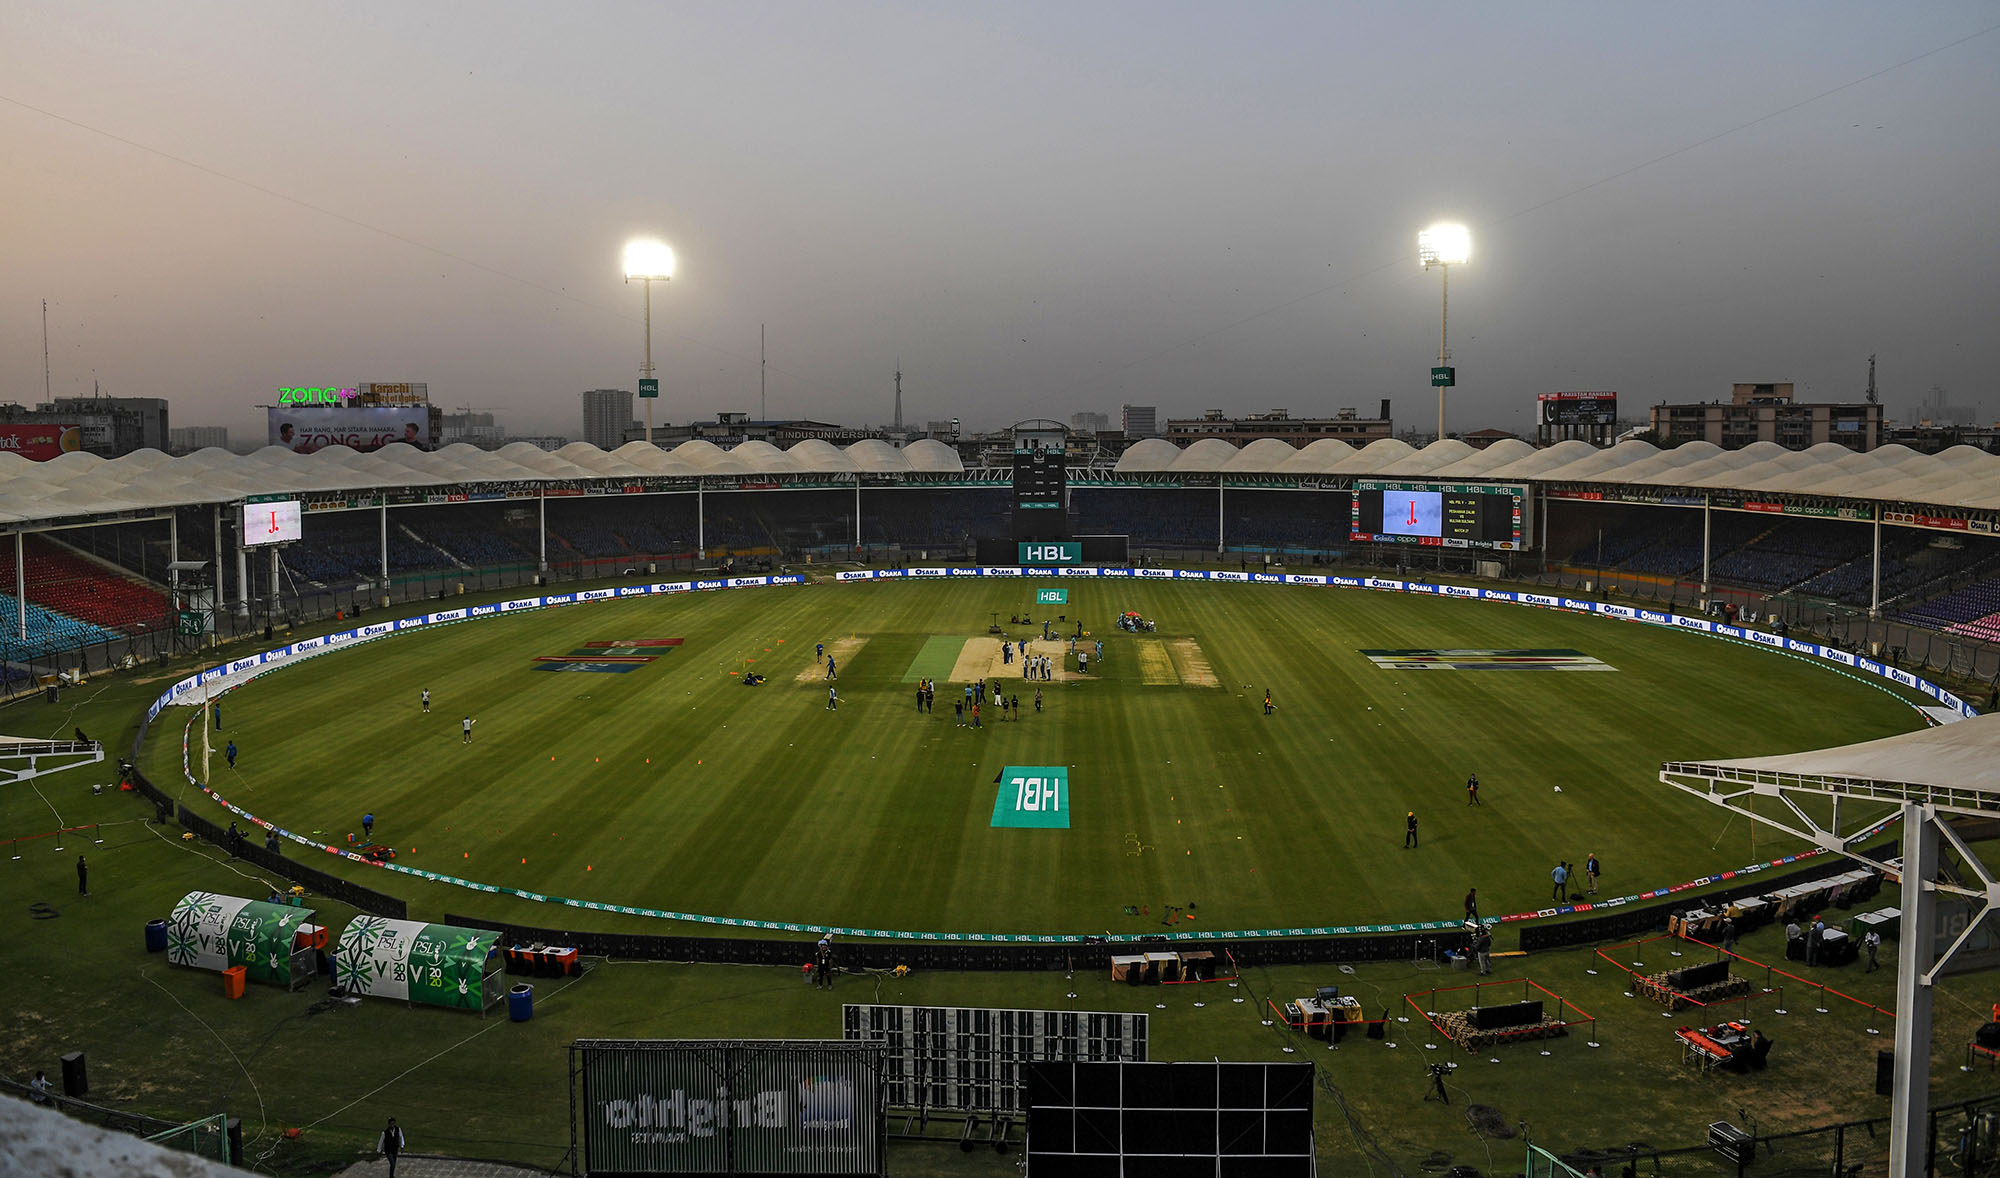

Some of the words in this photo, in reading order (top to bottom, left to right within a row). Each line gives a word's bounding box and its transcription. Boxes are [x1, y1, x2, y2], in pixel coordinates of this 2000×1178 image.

[340, 388, 357, 398] 4G
[371, 384, 409, 393] Karachi
[1406, 501, 1418, 525] J.
[268, 511, 279, 534] J.
[1027, 546, 1072, 560] HBL
[698, 580, 721, 589] OSAKA
[735, 578, 759, 586] OSAKA
[773, 575, 797, 584] OSAKA
[1294, 575, 1318, 584] OSAKA
[1333, 577, 1358, 586] OSAKA
[1372, 580, 1395, 588] OSAKA
[621, 586, 644, 595] OSAKA
[659, 583, 683, 592] OSAKA
[1409, 583, 1432, 592] OSAKA
[1447, 587, 1470, 596] OSAKA
[547, 596, 570, 604] OSAKA
[584, 591, 607, 599] OSAKA
[1040, 592, 1062, 600] HBL
[1486, 590, 1510, 600] OSAKA
[1526, 594, 1550, 604] OSAKA
[1565, 599, 1589, 610] OSAKA
[473, 606, 495, 615] OSAKA
[1604, 605, 1627, 616] OSAKA
[436, 612, 459, 620] OSAKA
[1641, 610, 1665, 622] OSAKA
[400, 618, 422, 628] OSAKA
[1680, 618, 1702, 628] OSAKA
[365, 625, 386, 636] OSAKA
[1716, 624, 1739, 637] OSAKA
[330, 633, 351, 642] OSAKA
[1753, 632, 1775, 645] OSAKA
[298, 641, 317, 652] OSAKA
[1789, 640, 1813, 654] OSAKA
[266, 650, 286, 661] OSAKA
[1827, 649, 1847, 662] OSAKA
[233, 659, 254, 671] OSAKA
[1860, 659, 1879, 674] OSAKA
[202, 670, 220, 682] OSAKA
[1892, 670, 1910, 685] OSAKA
[1010, 778, 1059, 811] HBL
[203, 912, 219, 924] PSL
[233, 917, 250, 929] PSL
[200, 934, 210, 951] V
[216, 937, 225, 946] 20
[377, 937, 398, 950] PSL
[413, 941, 434, 953] PSL
[216, 946, 225, 955] 20
[229, 940, 240, 957] V
[246, 942, 256, 953] 20
[246, 952, 256, 962] 20
[375, 960, 387, 978] V
[394, 963, 405, 972] 20
[410, 964, 423, 983] V
[430, 968, 441, 978] 20
[394, 972, 406, 982] 20
[430, 977, 442, 987] 20
